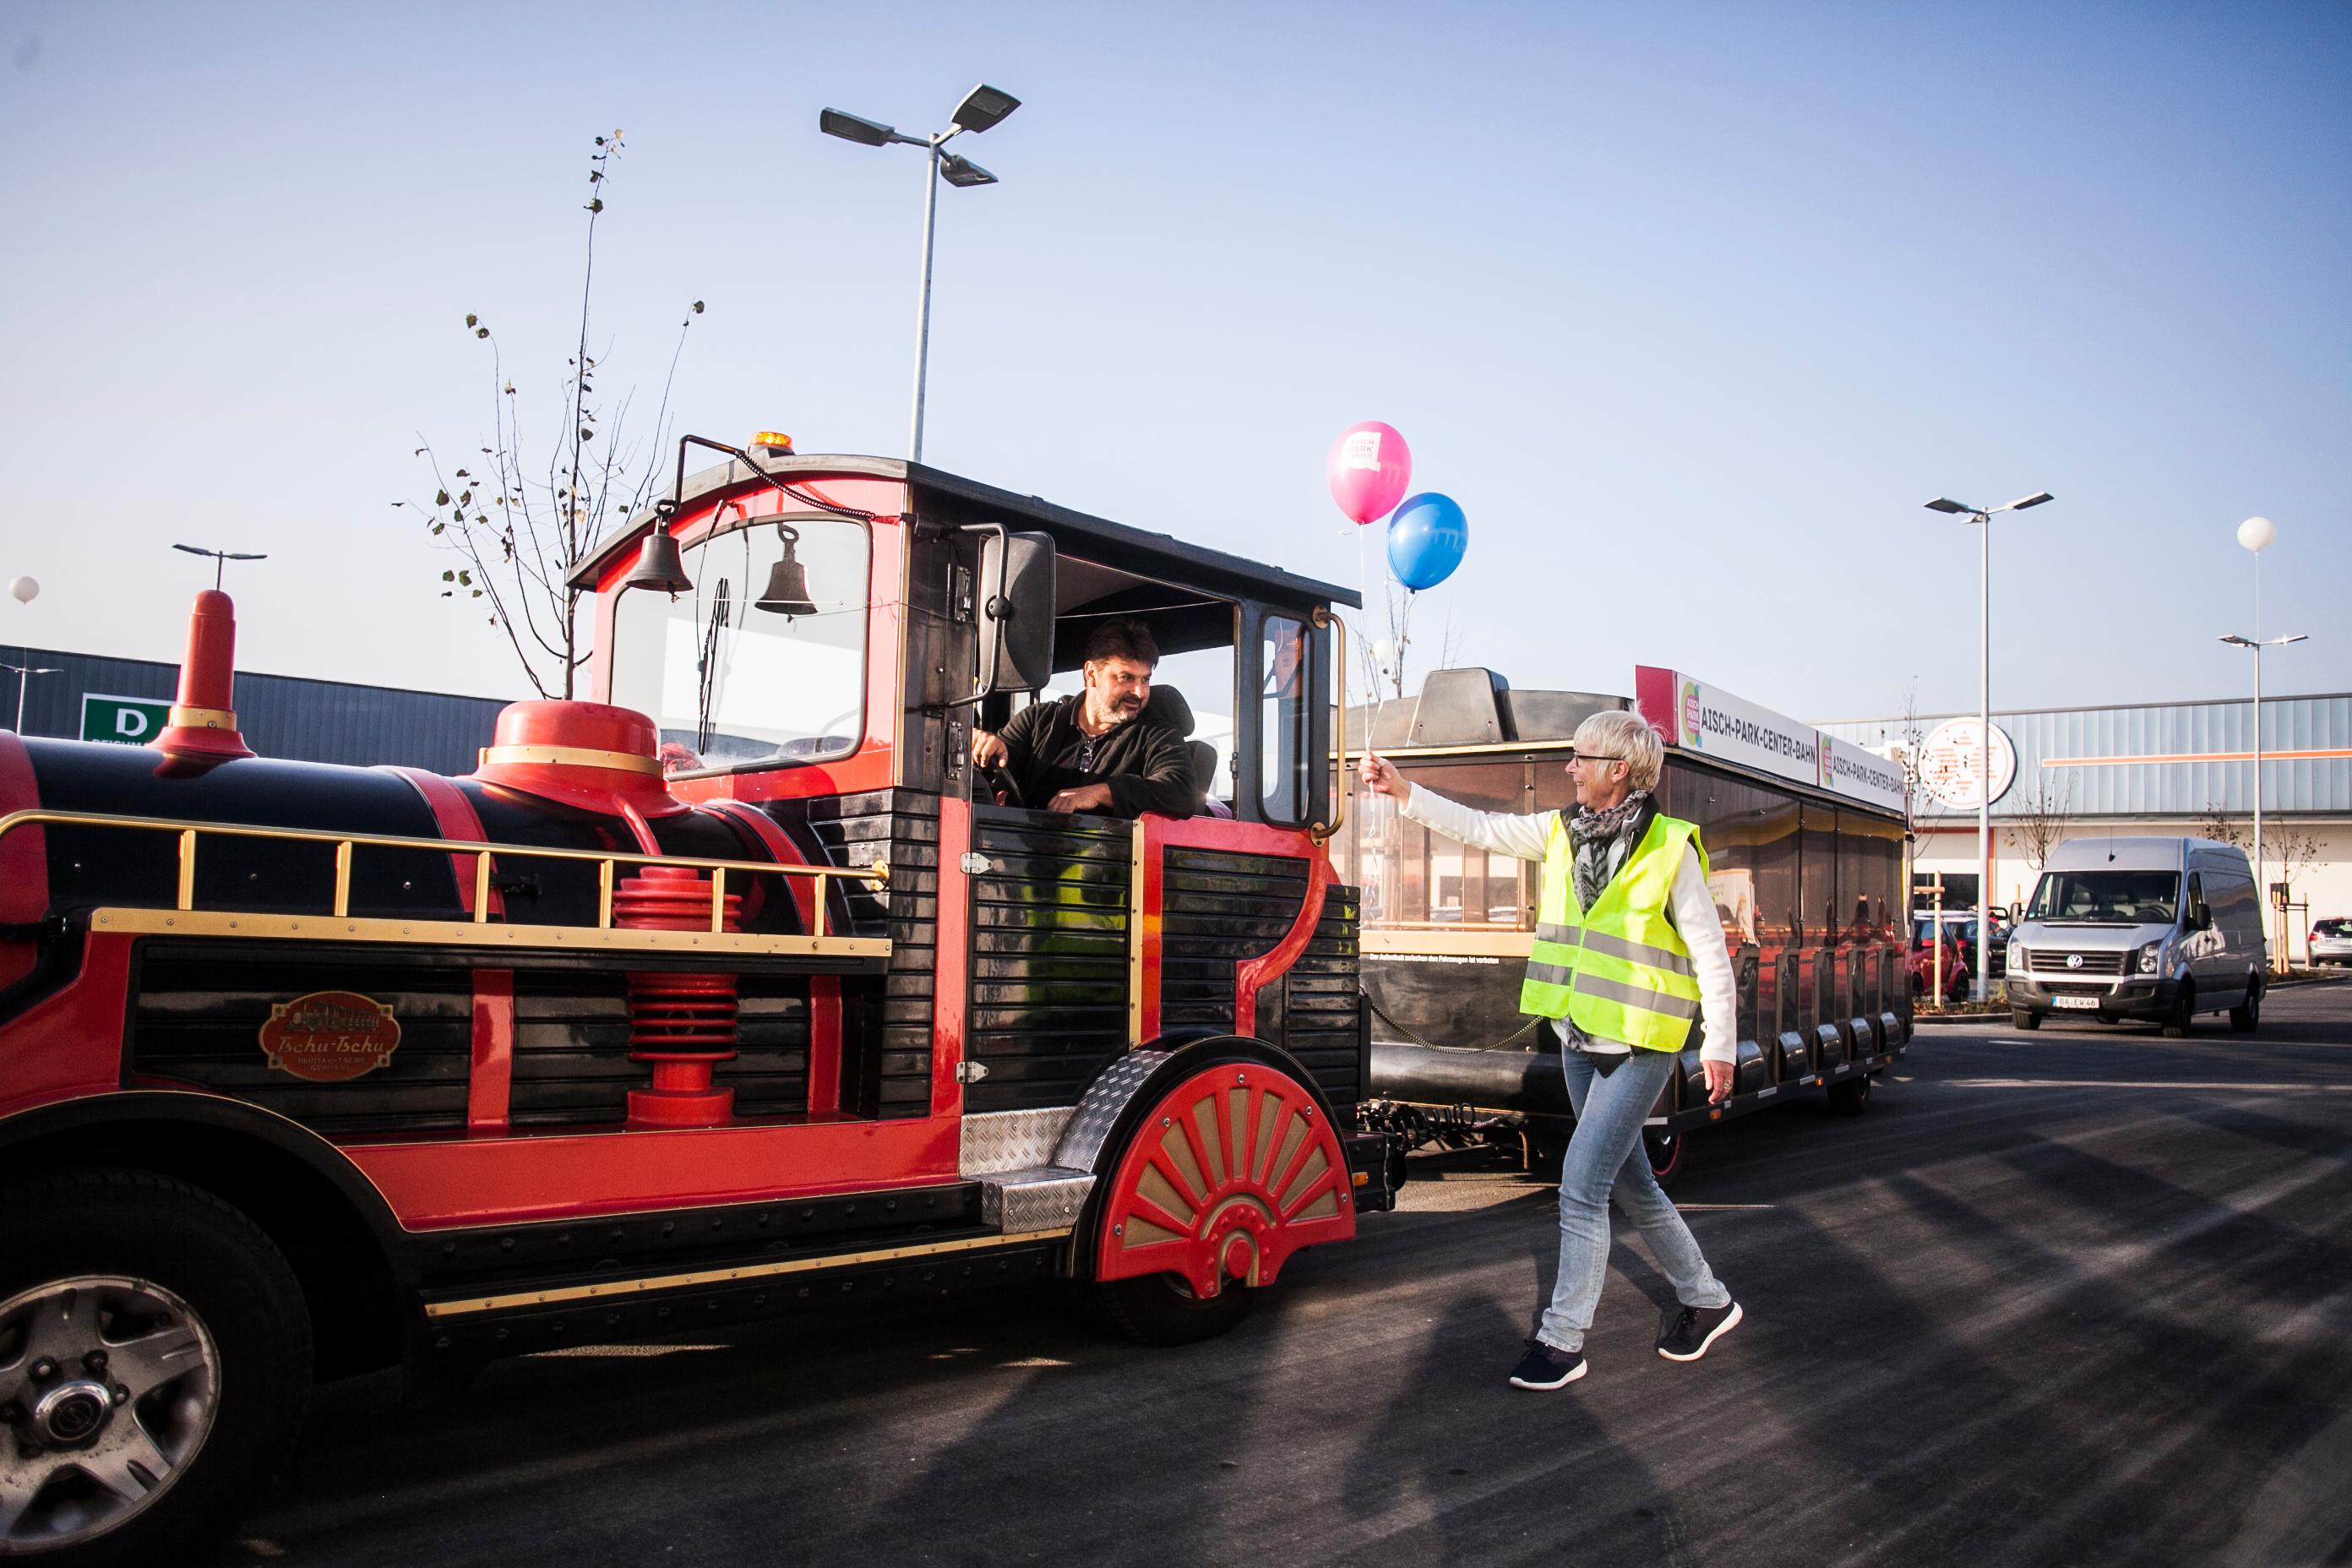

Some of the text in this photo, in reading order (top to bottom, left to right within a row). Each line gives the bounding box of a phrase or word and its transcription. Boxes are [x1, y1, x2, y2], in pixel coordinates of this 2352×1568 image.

[116, 708, 148, 737] D
[1701, 706, 1816, 765] AISCH-PARK-CENTER-BAHN
[1832, 755, 1904, 796] AISCH-PARK-CENTER-BAHN
[278, 1034, 384, 1054] Tschu-Tschu
